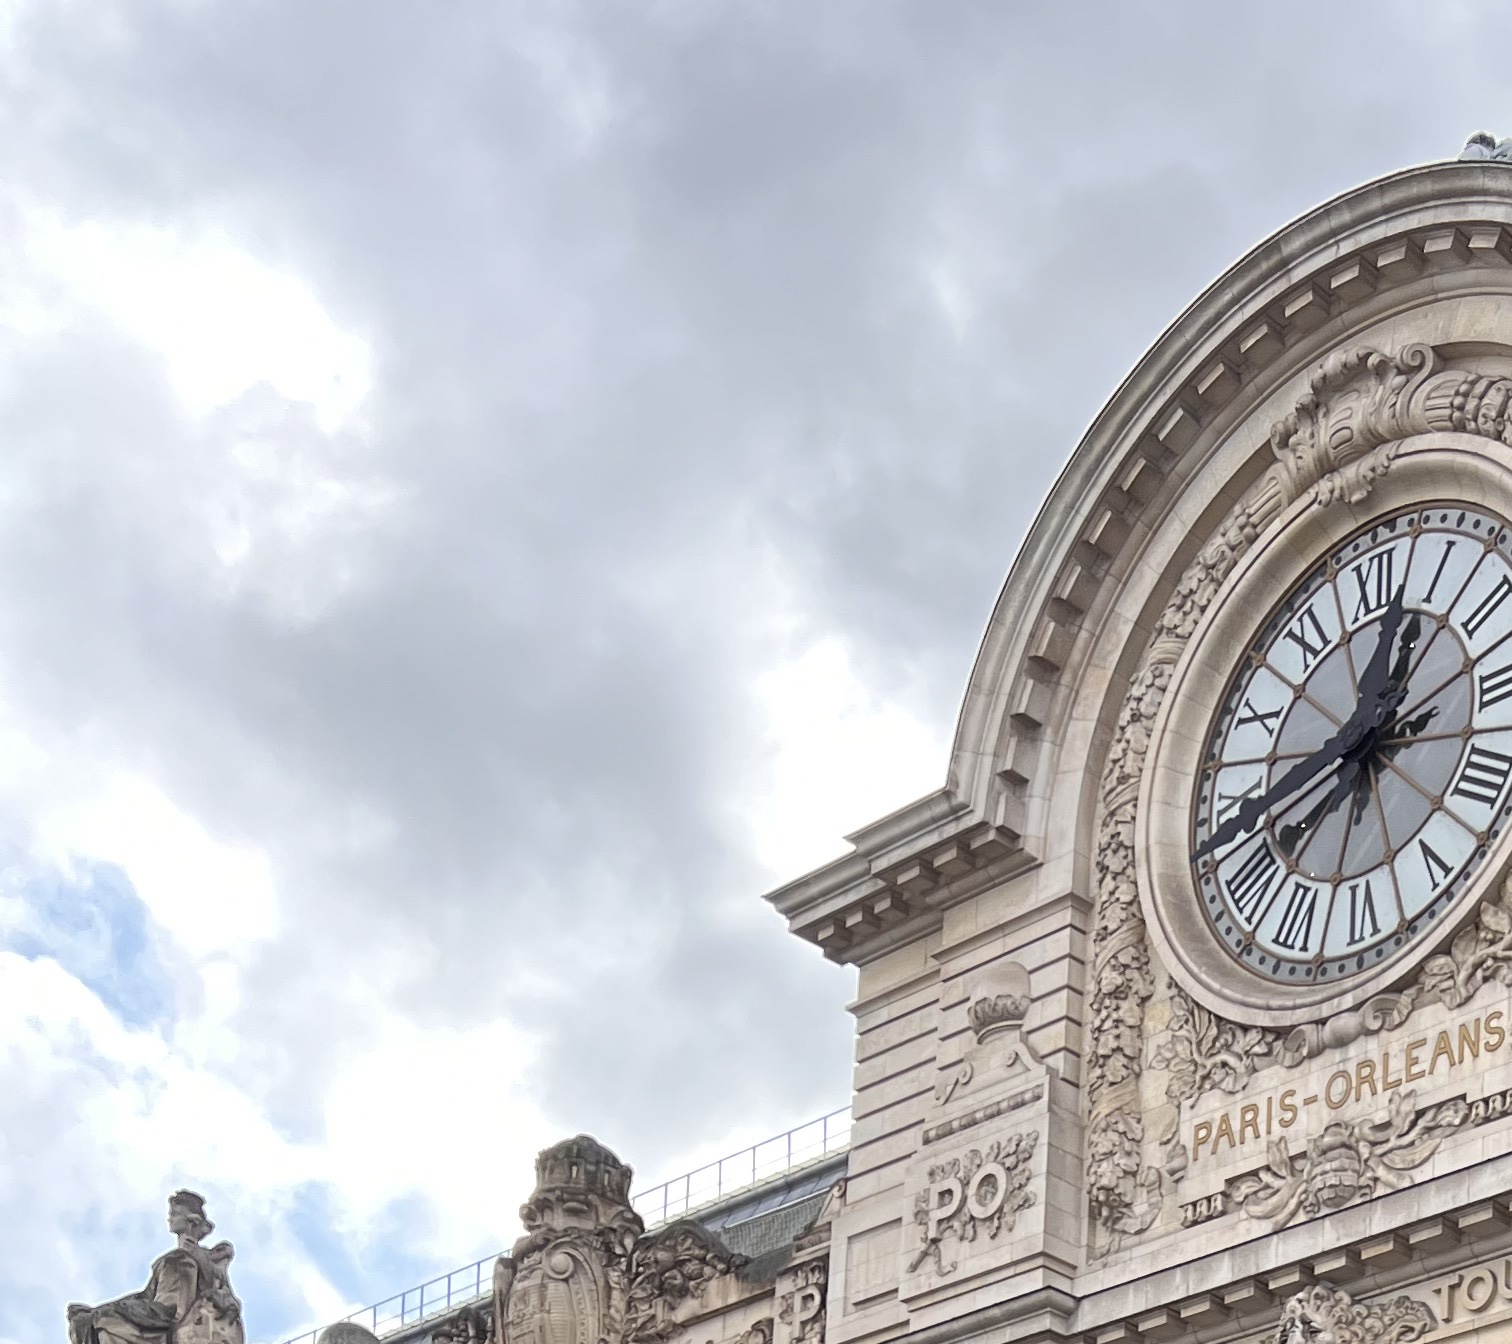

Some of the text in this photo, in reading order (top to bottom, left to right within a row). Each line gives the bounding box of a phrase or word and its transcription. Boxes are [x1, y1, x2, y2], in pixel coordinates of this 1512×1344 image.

[1351, 544, 1398, 626] XII
[1421, 540, 1457, 604] I
[1283, 603, 1332, 674] XI
[1235, 697, 1284, 738] X
[1226, 836, 1279, 925] VIII
[1418, 838, 1455, 892] V
[1272, 880, 1319, 952] VII
[1346, 879, 1382, 947] VI
[1193, 1011, 1507, 1161] PARIS-ORLEANS
[927, 1162, 1007, 1241] PO
